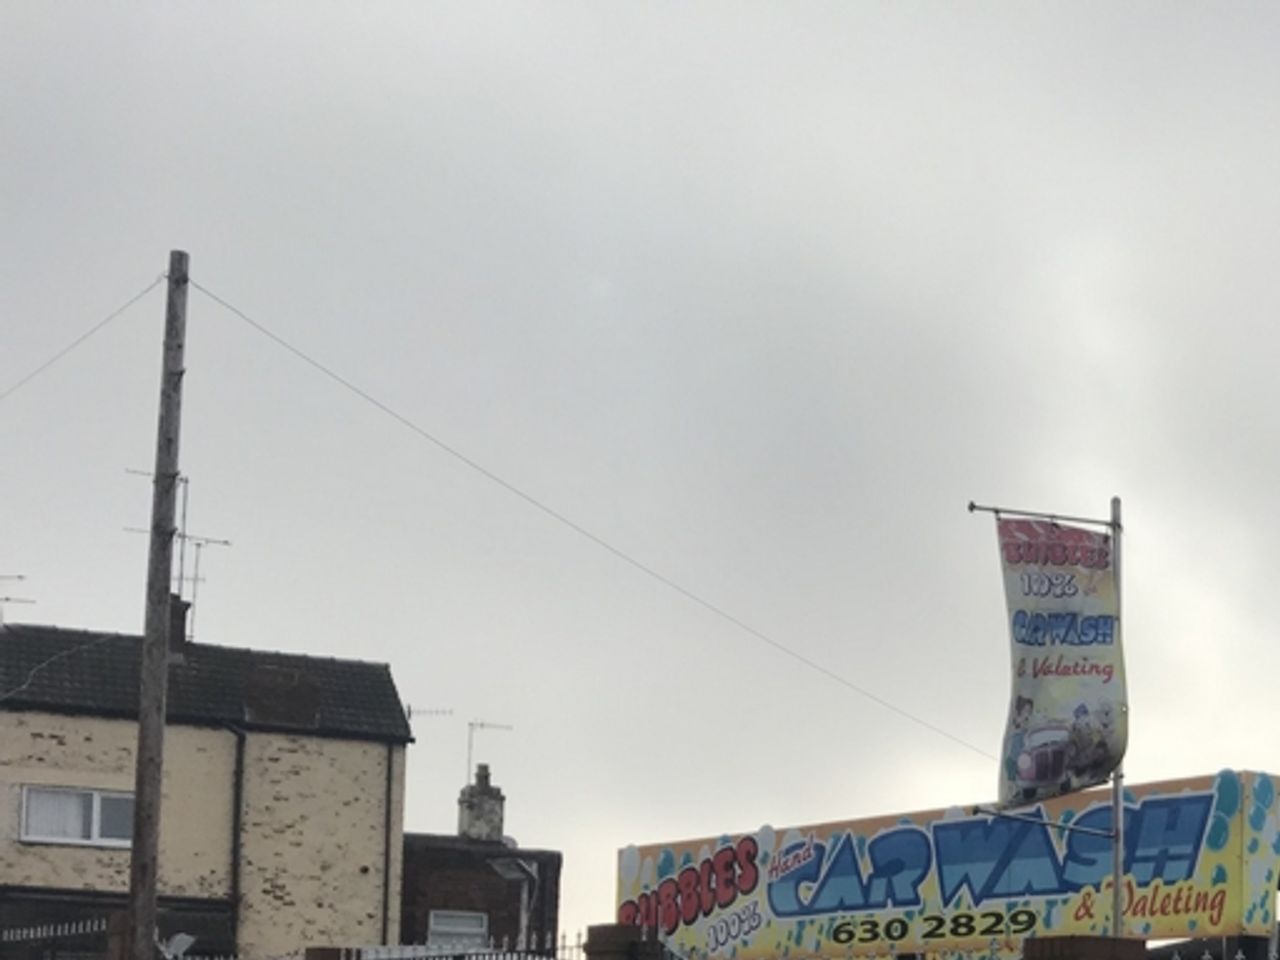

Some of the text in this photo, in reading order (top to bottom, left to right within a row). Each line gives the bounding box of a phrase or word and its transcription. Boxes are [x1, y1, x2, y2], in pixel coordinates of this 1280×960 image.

[1032, 653, 1114, 684] Valeting
[767, 832, 815, 878] Hand
[617, 835, 759, 936] BUBBLES
[706, 900, 762, 953] 100%
[832, 909, 1037, 944] 630 2829
[1074, 892, 1095, 922] &
